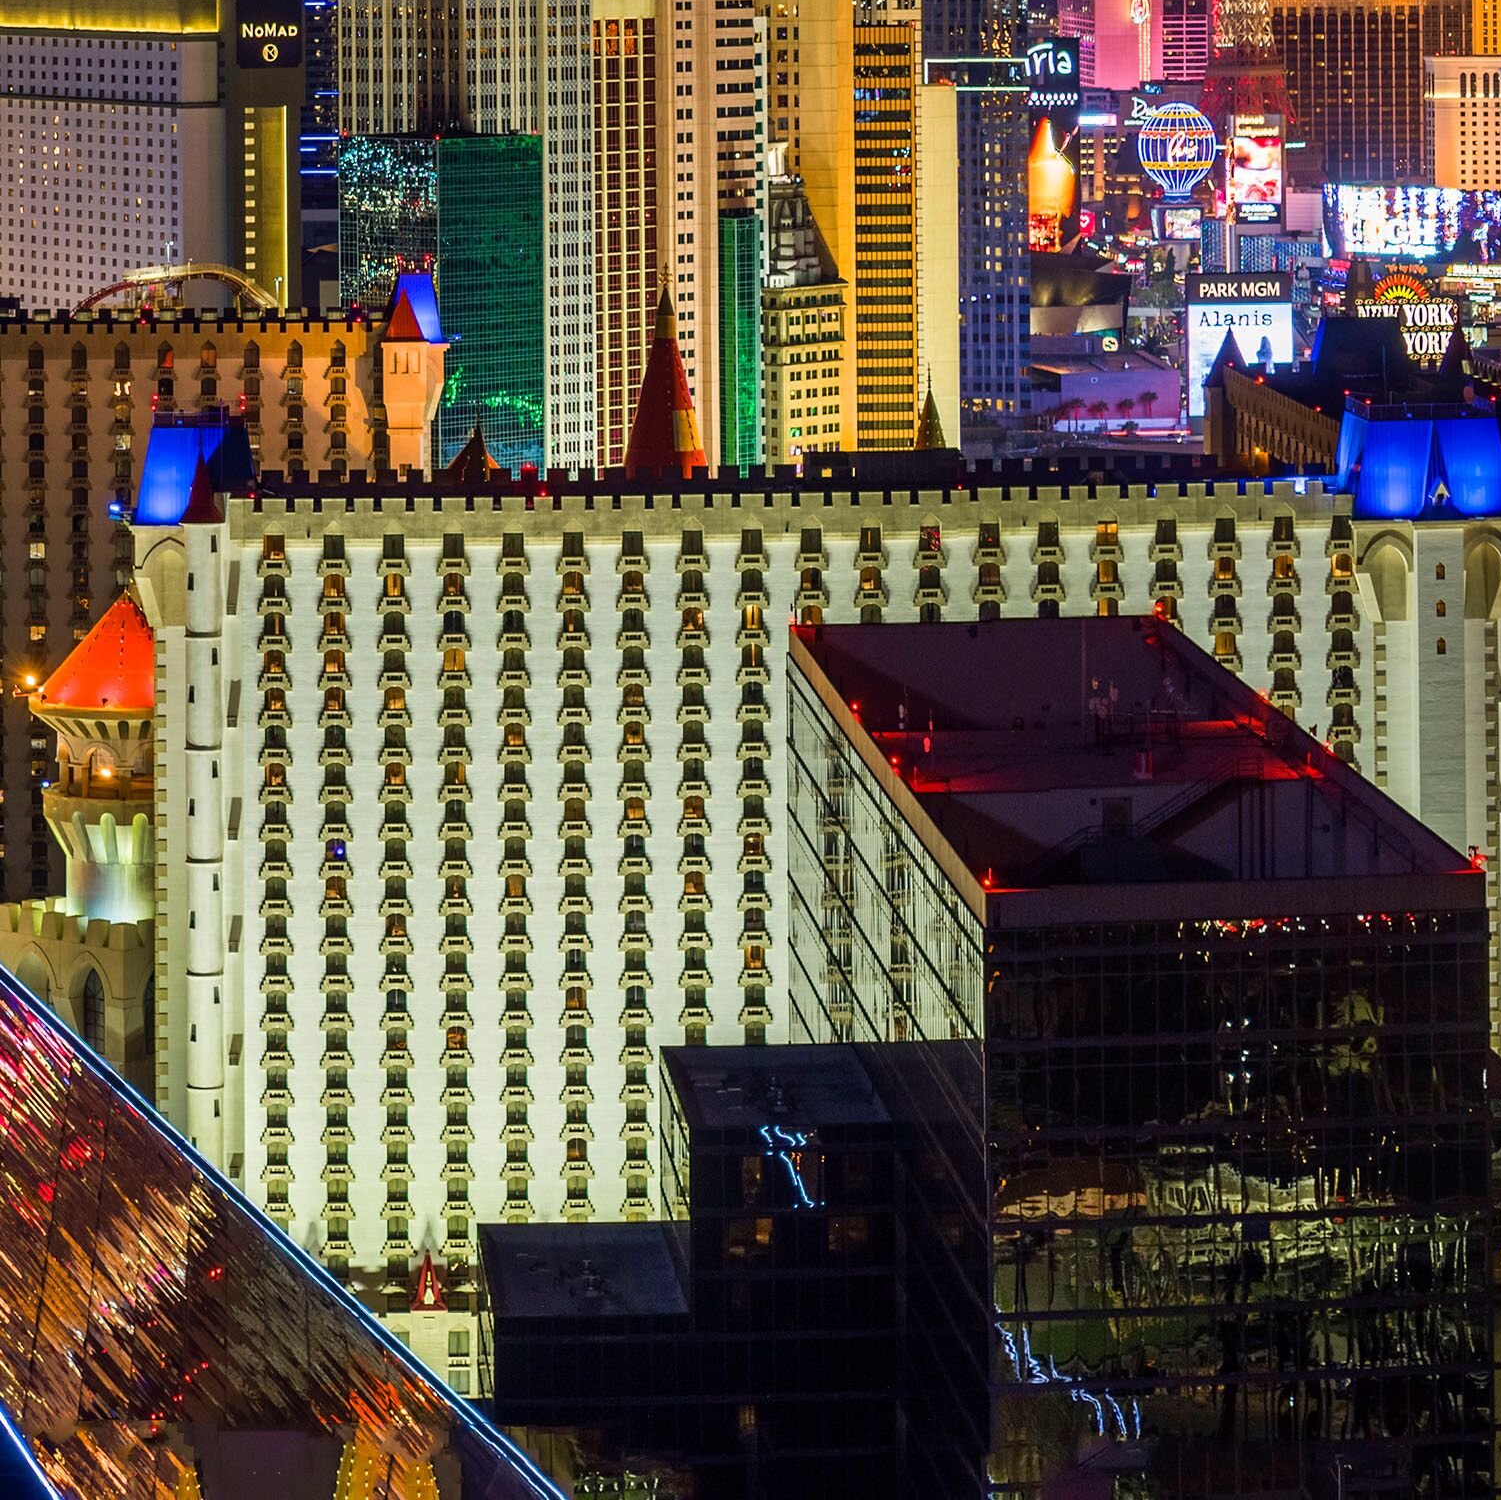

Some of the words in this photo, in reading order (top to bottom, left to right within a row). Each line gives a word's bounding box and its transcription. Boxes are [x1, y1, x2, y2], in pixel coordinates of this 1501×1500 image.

[1199, 282, 1238, 298] PARK
[1241, 281, 1280, 297] MGM
[1199, 310, 1273, 327] Alanis
[1402, 304, 1455, 327] YORK
